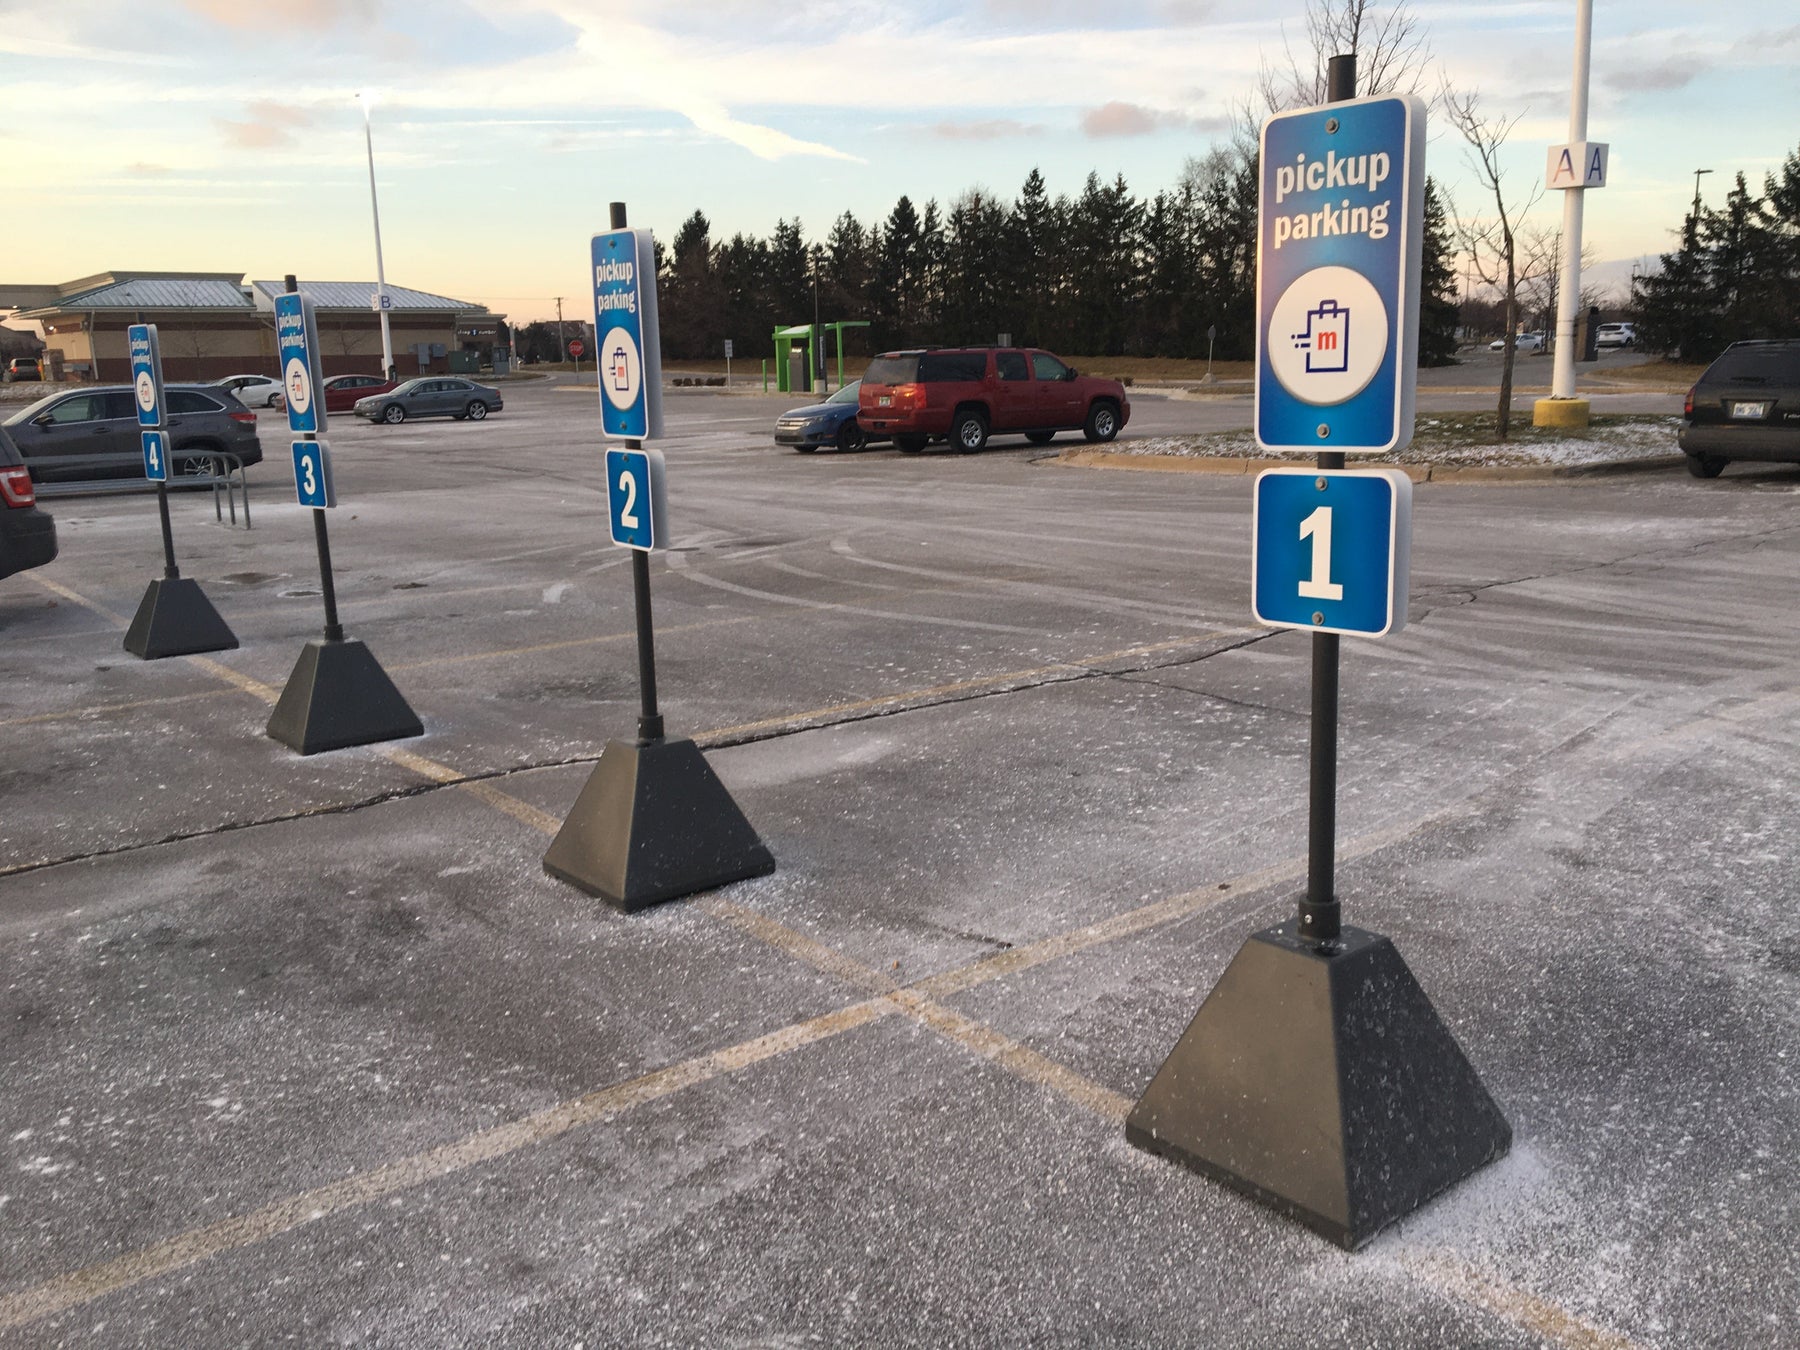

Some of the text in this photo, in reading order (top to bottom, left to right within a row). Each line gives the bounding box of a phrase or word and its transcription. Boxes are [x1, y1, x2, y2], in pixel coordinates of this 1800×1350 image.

[1276, 150, 1390, 203] pickup
[1553, 148, 1575, 183] A
[1588, 147, 1602, 181] A
[1274, 199, 1391, 249] parking
[596, 258, 633, 287] pickup
[381, 295, 391, 308] B
[597, 288, 636, 315] parking
[1317, 331, 1337, 350] m
[149, 441, 159, 471] 4
[301, 454, 316, 496] 3
[619, 470, 638, 529] 2
[1298, 506, 1343, 601] 1
